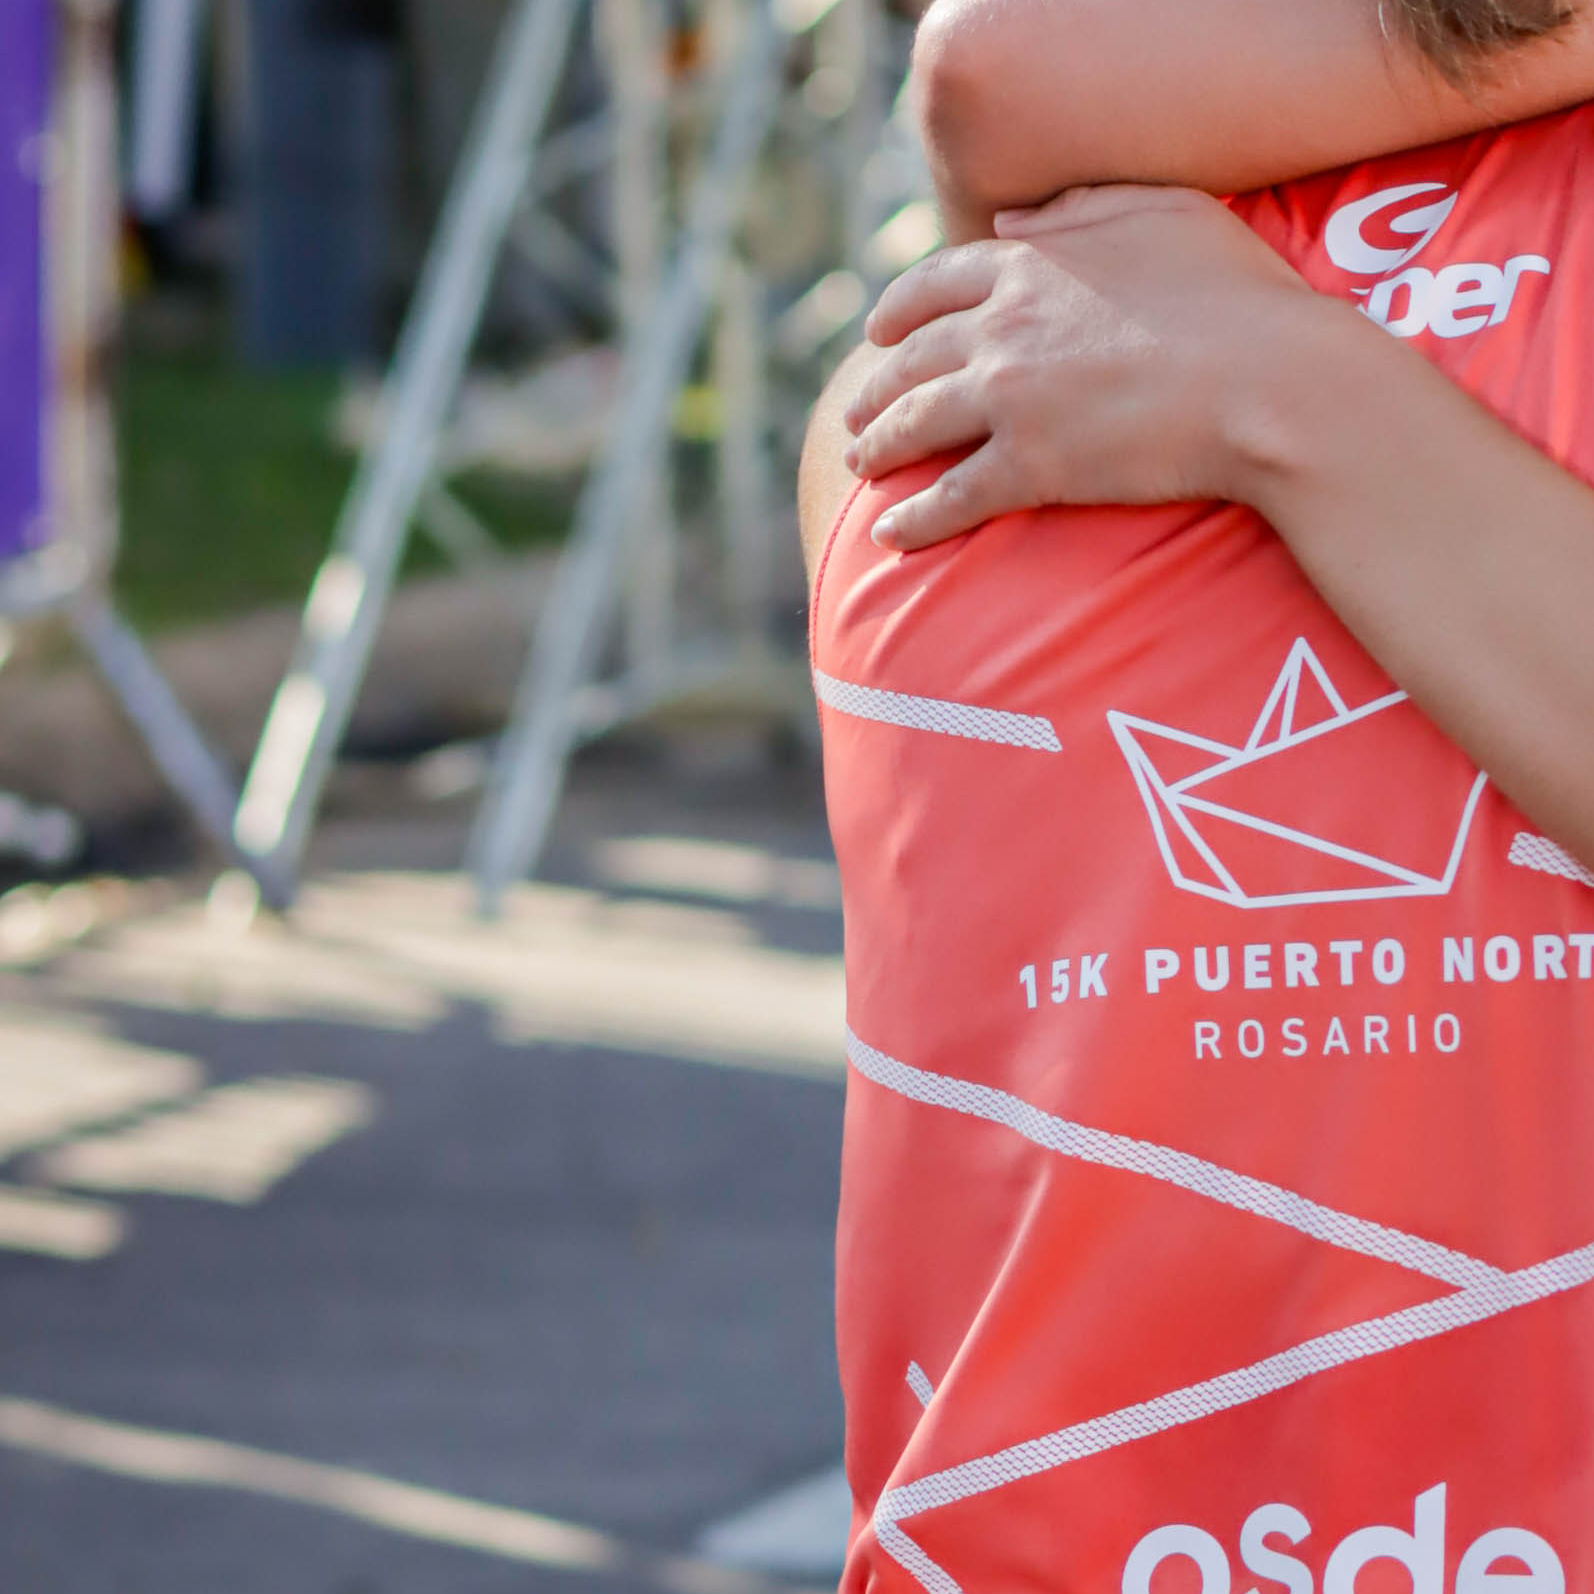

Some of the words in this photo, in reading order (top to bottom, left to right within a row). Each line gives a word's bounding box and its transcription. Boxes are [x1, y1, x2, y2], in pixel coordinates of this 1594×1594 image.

[1351, 254, 1550, 339] per
[1019, 952, 1109, 1009] 15K
[1144, 938, 1405, 994] PUERTO
[1194, 1013, 1461, 1059] ROSARIO
